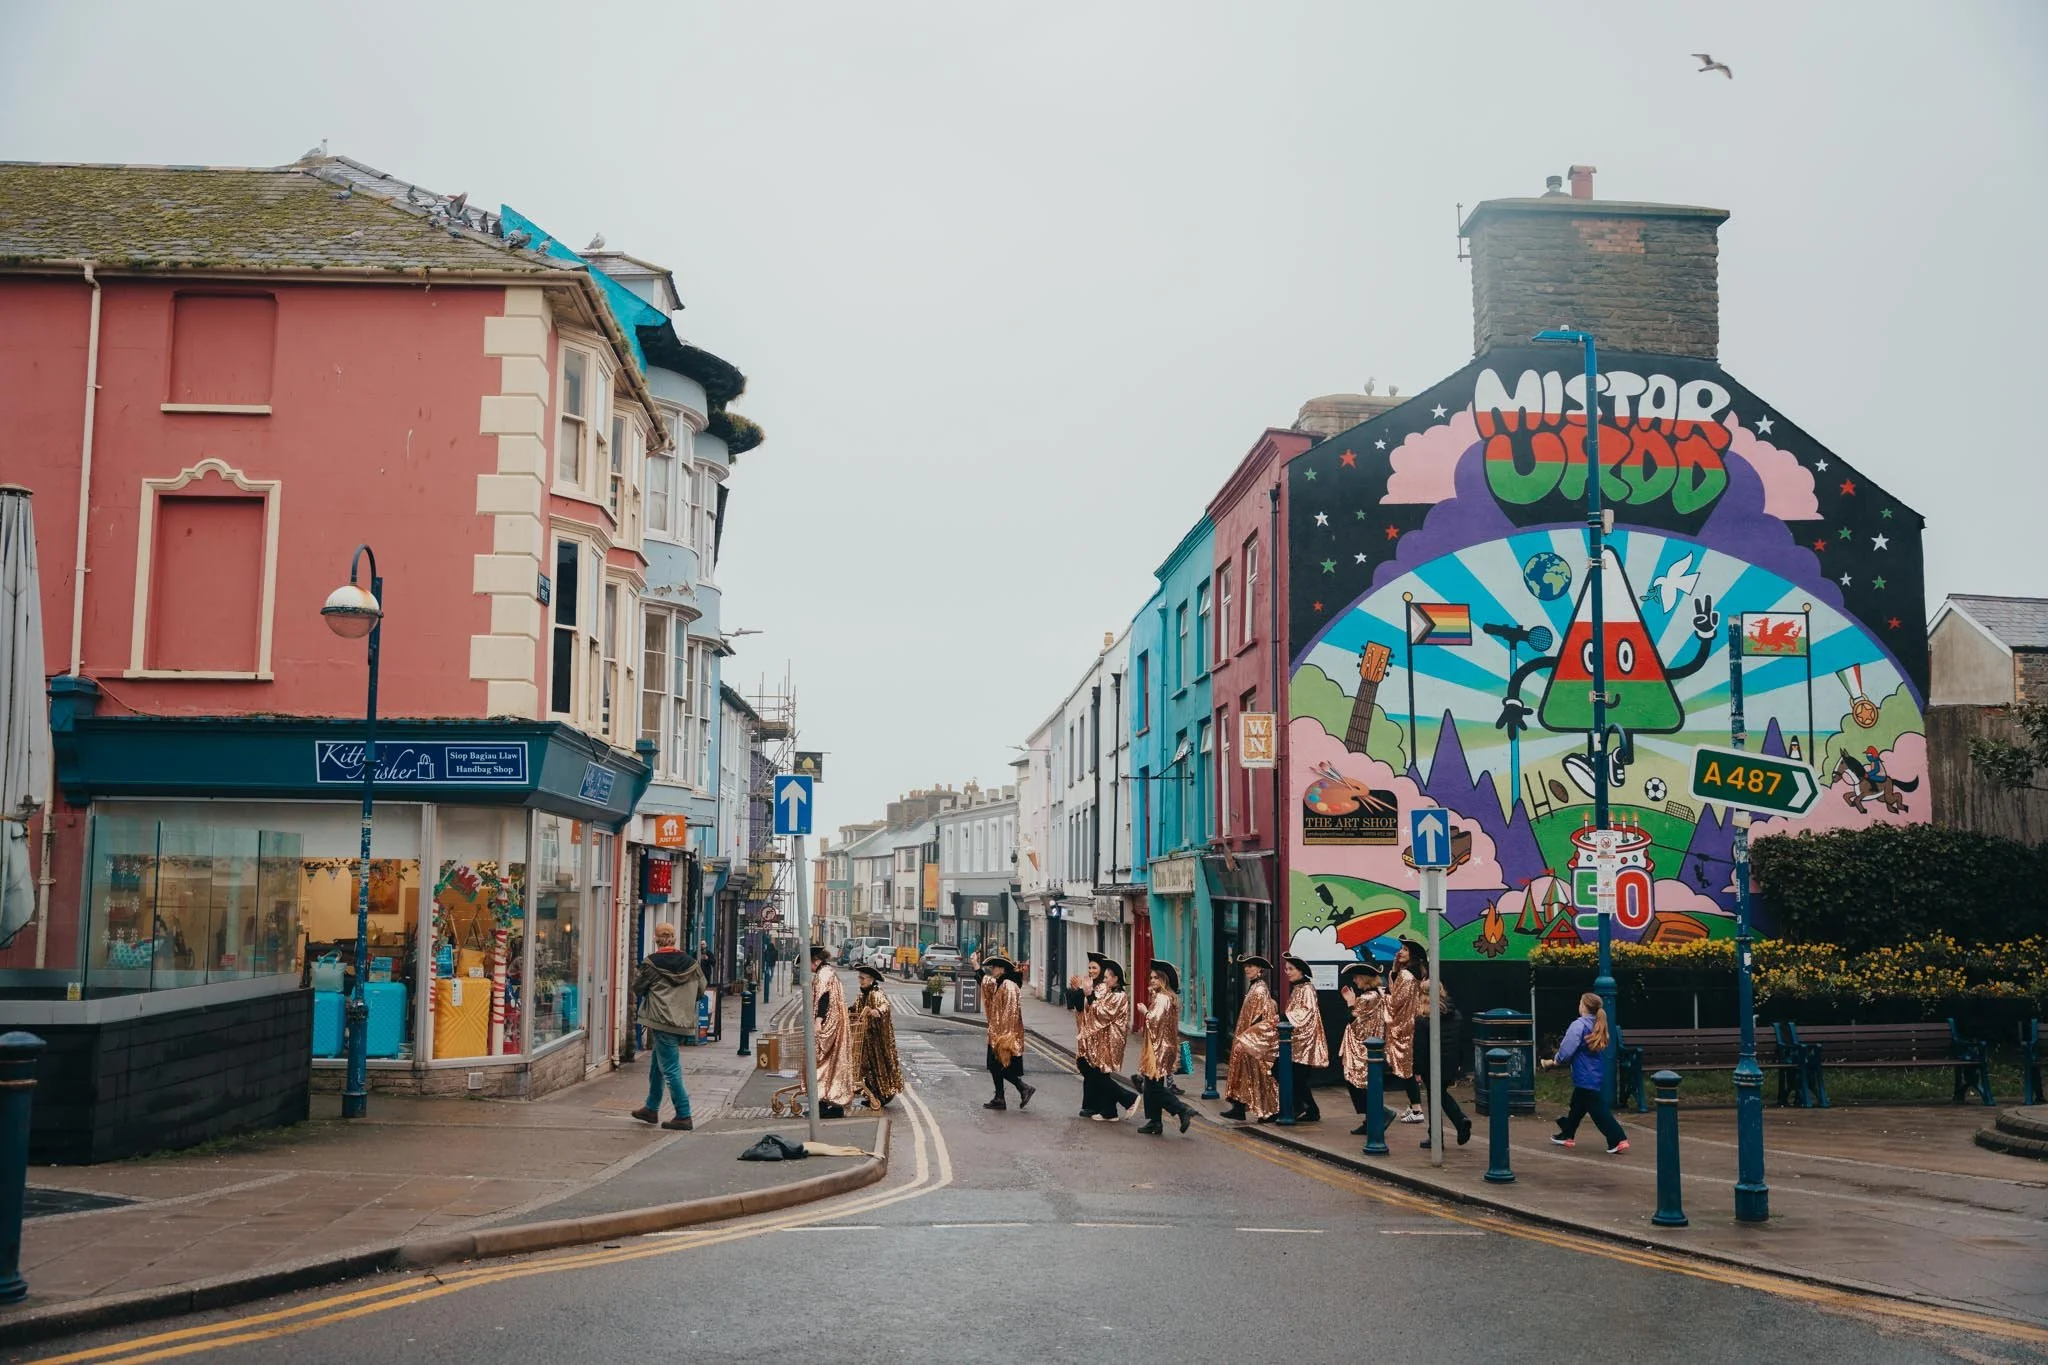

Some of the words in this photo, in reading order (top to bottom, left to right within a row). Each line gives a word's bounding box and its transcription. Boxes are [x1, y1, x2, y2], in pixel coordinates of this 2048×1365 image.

[1474, 368, 1732, 450] MISTAR
[1485, 423, 1727, 514] URDD
[1247, 720, 1268, 735] W
[1248, 738, 1267, 752] N
[449, 752, 468, 761] Siop
[470, 752, 497, 761] Bagiau
[499, 752, 518, 760] Llaw
[456, 765, 492, 774] Handbag
[493, 766, 514, 775] Shop
[1703, 761, 1782, 795] A487
[1305, 817, 1332, 828] THE
[1335, 817, 1360, 828] ART
[1362, 817, 1397, 828] SHOP
[1574, 869, 1652, 930] 50
